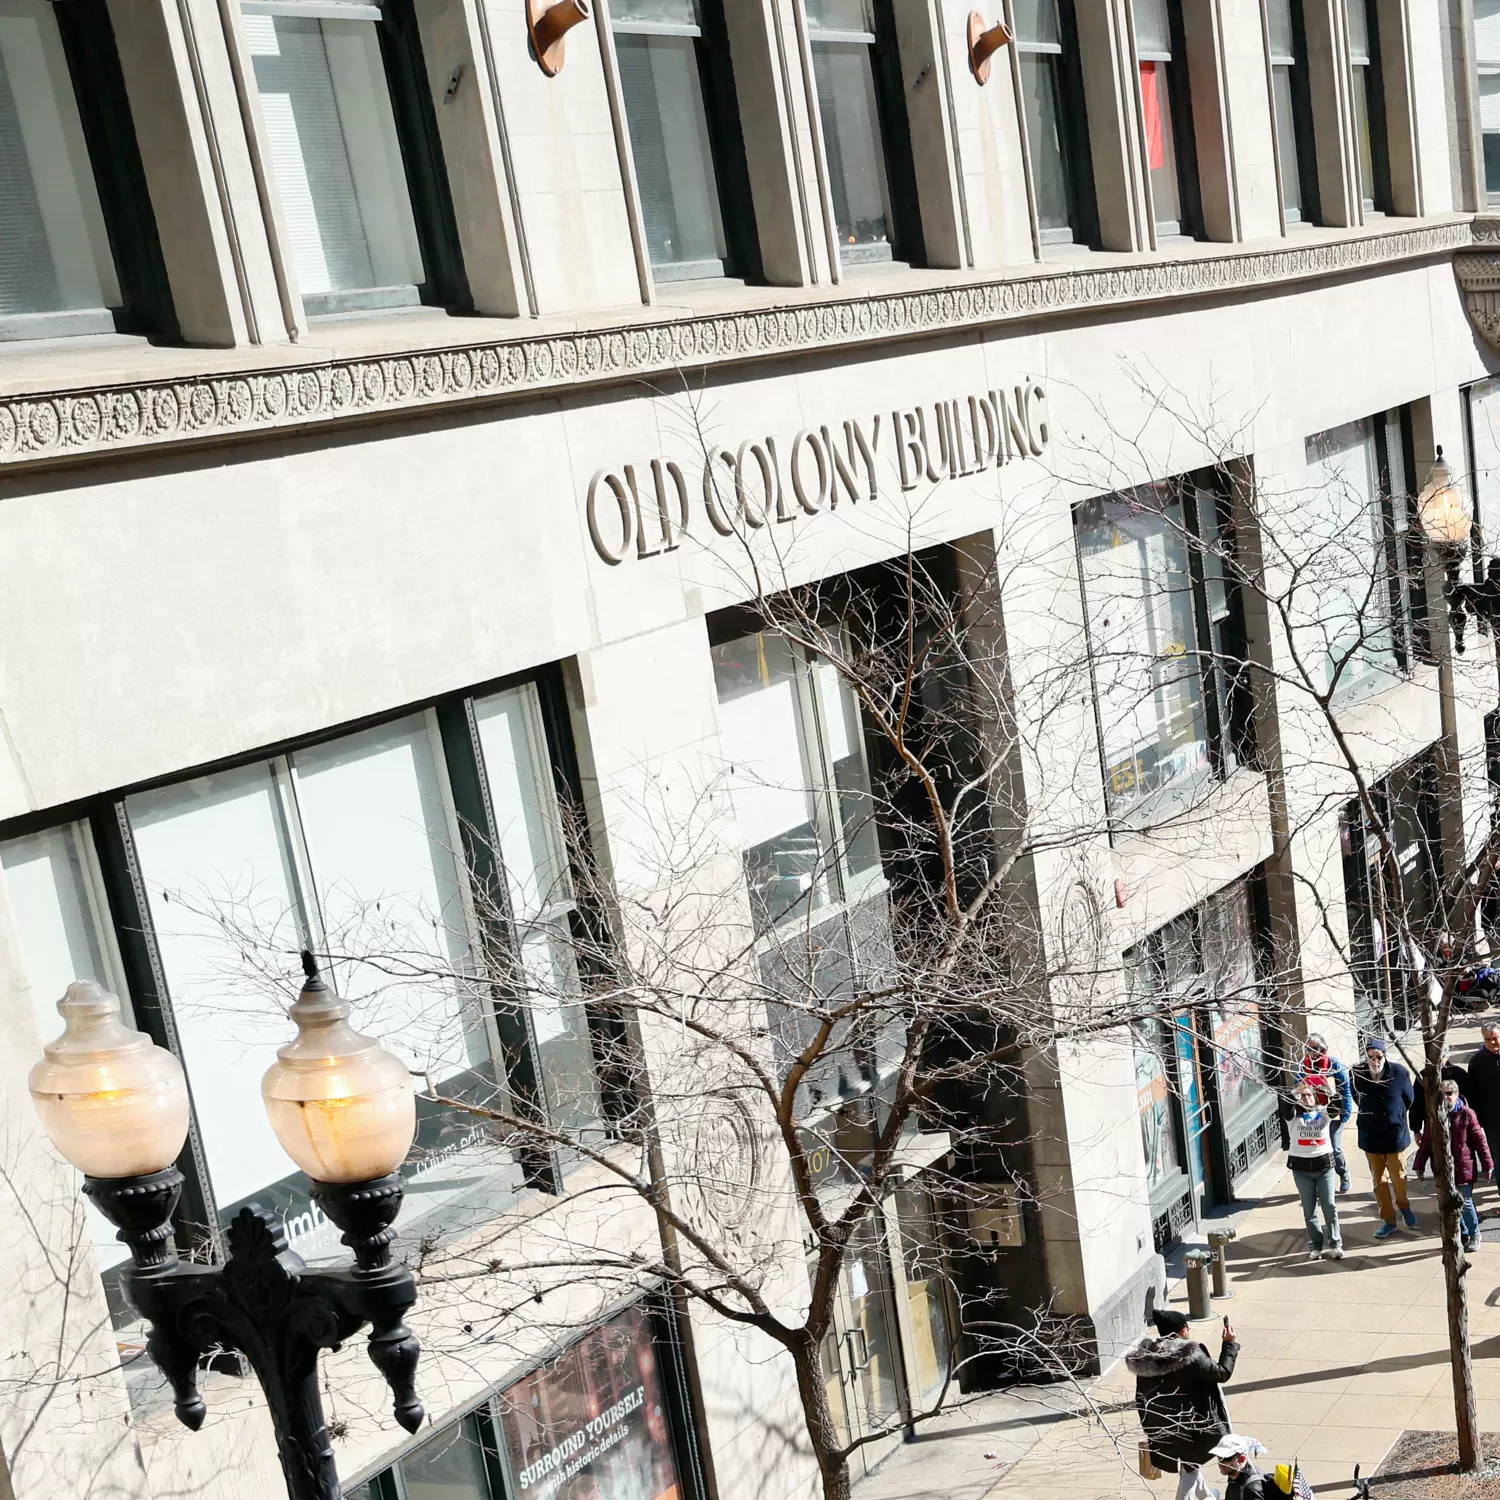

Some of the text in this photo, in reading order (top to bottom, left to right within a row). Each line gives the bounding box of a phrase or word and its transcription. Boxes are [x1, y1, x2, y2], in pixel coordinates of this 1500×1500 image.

[587, 381, 1048, 566] OLD COLONY BUILDING
[519, 1385, 645, 1490] SURROUND YOURSELF
[565, 1446, 600, 1481] historic
[600, 1425, 629, 1454] details
